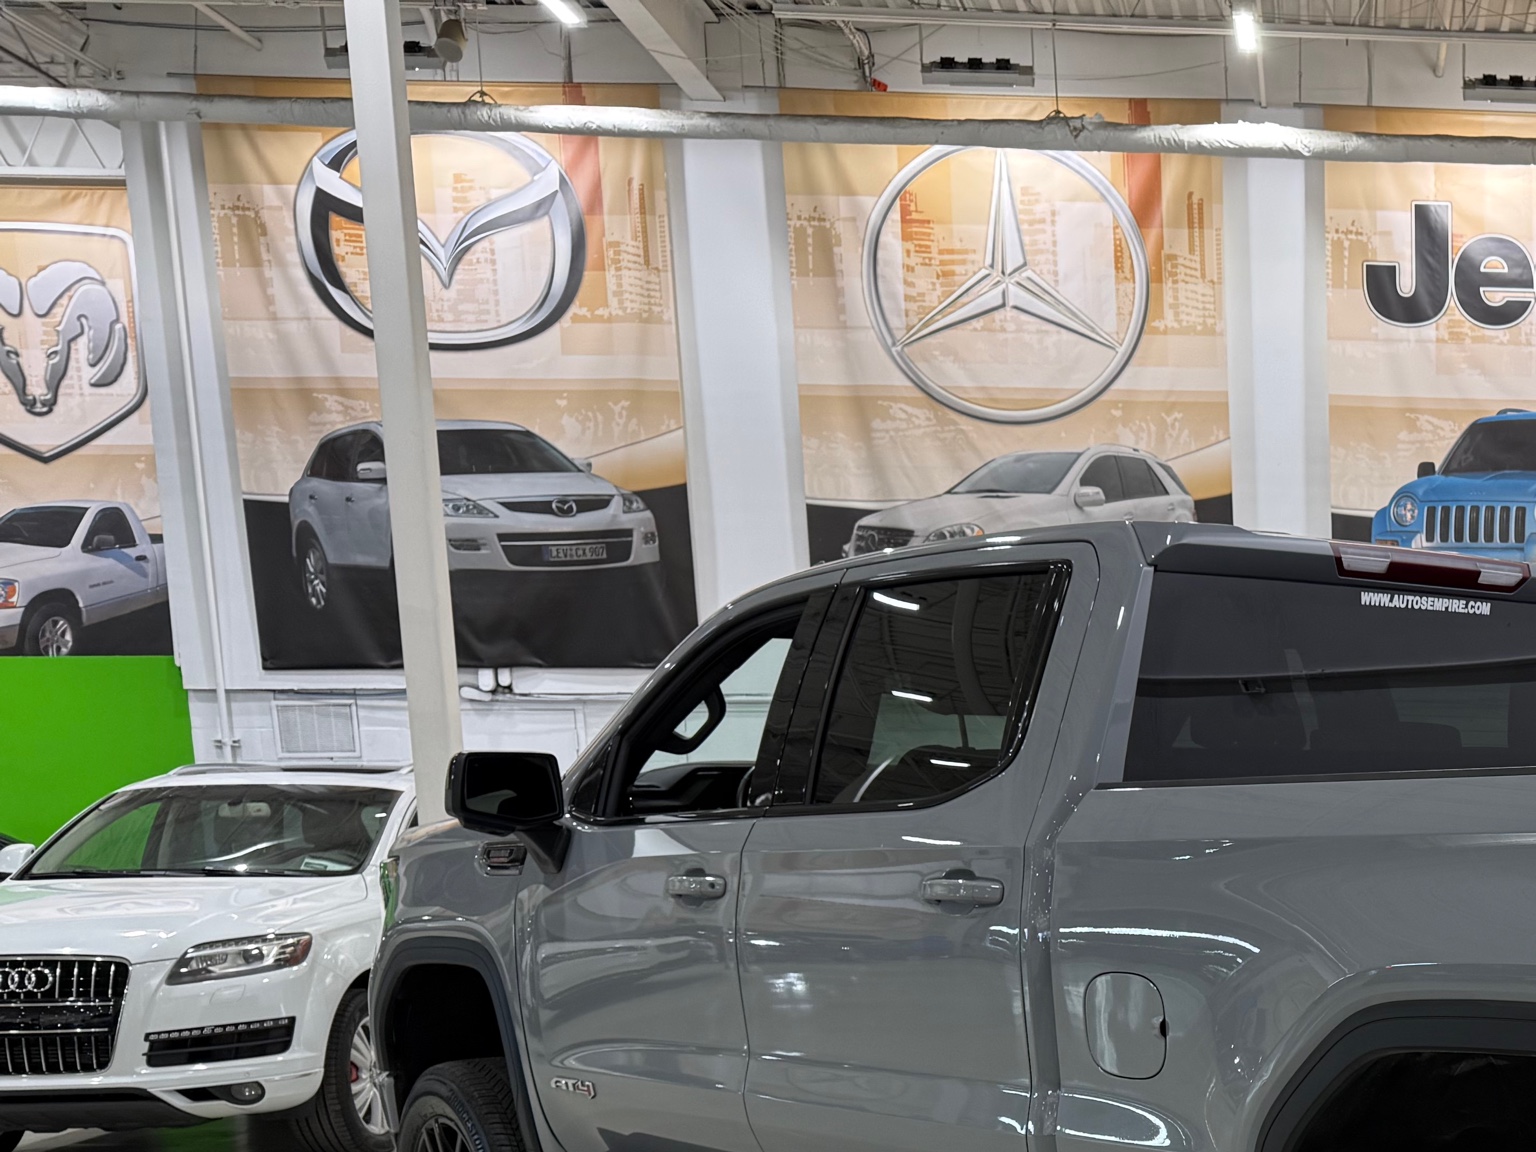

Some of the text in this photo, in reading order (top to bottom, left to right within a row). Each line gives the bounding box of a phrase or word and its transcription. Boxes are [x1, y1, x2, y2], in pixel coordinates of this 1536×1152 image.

[549, 547, 568, 559] LEV
[589, 546, 605, 557] 907
[1360, 591, 1491, 615] WWW.AUTOSEMPIRE.COM
[550, 1076, 596, 1100] AT4
